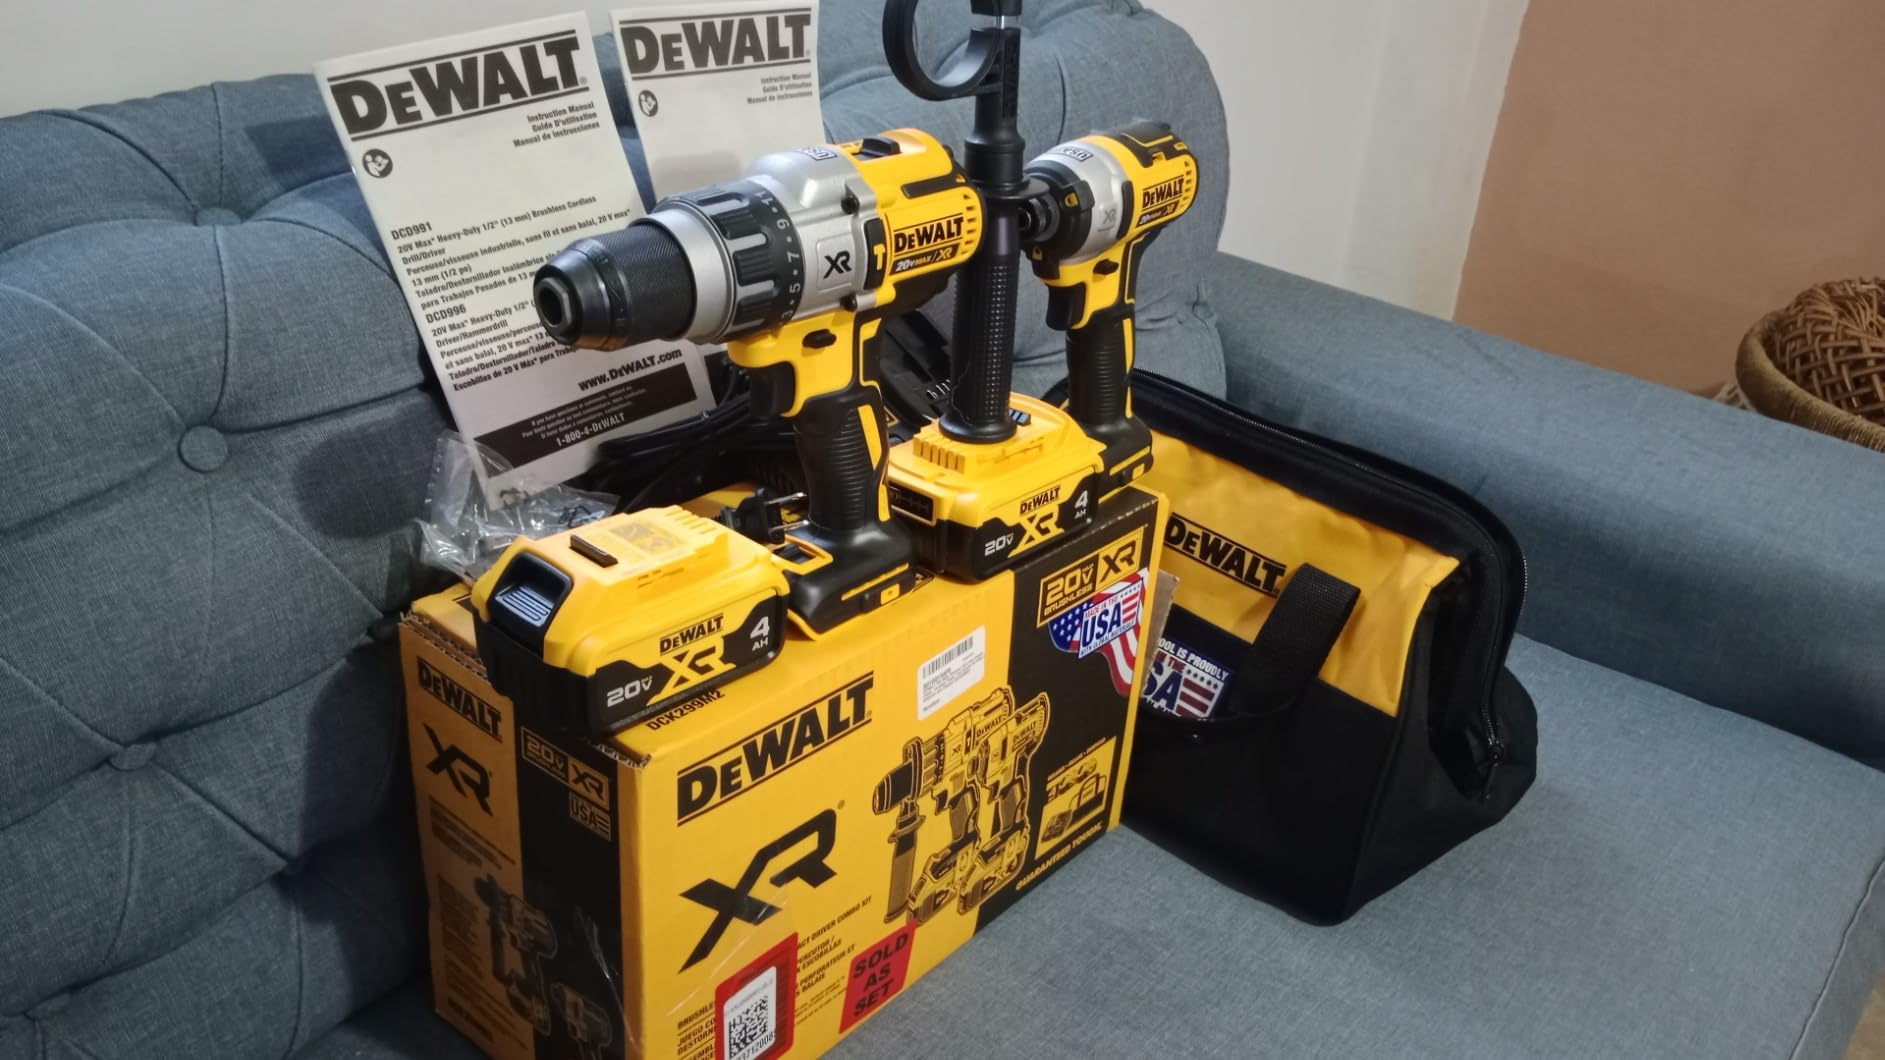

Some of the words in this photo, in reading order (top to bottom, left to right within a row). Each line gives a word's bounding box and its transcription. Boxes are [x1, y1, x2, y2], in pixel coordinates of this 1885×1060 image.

[620, 15, 811, 74] DEWALT
[330, 35, 580, 134] DEWALT
[527, 107, 567, 122] Instruction
[568, 100, 594, 113] Manual
[531, 121, 552, 132] Guide
[554, 111, 597, 127] D'utilisation
[513, 134, 540, 146] Manual
[541, 132, 551, 140] de
[1143, 178, 1185, 209] DEWALT
[390, 221, 432, 241] DCD991
[397, 243, 414, 254] 20V
[436, 224, 481, 244] Heavy-Duty
[499, 216, 513, 227] (13
[513, 212, 531, 223] mm)
[531, 202, 566, 218] Brushless
[566, 194, 596, 208] Cordless
[894, 217, 964, 253] DEWALT
[401, 246, 446, 265] Drill/Driver
[406, 249, 479, 276] Perceuse/visseuse
[524, 233, 541, 243] sans
[542, 230, 551, 238] fil
[560, 223, 577, 233] sans
[597, 215, 607, 223] 20
[787, 251, 800, 263] 7
[411, 278, 422, 287] 13
[423, 274, 439, 283] mm
[439, 267, 458, 280] (1/2
[457, 264, 472, 275] po)
[415, 267, 501, 299] Taladro/Destornillador
[823, 250, 852, 279] XR
[420, 298, 440, 310] para
[439, 287, 474, 305] Trabajos
[474, 278, 505, 293] Pesados
[506, 274, 517, 283] de
[517, 271, 528, 280] 13
[789, 282, 801, 294] 5
[425, 303, 467, 323] DCD996
[431, 325, 447, 336] 20V
[469, 306, 513, 325] Heavy-Duty
[435, 319, 508, 347] Driver/Hammerdrill
[444, 361, 454, 369] et
[454, 355, 474, 366] sans
[496, 343, 507, 352] 20
[534, 331, 543, 340] 13
[448, 341, 556, 380] Taladro/Destornillador/Taladro
[452, 372, 492, 391] Escobillas
[492, 368, 502, 377] de
[502, 364, 512, 374] 20
[512, 362, 519, 370] V
[538, 352, 554, 363] para
[1020, 487, 1060, 514] DEWALT
[985, 533, 1014, 557] 20V
[1007, 503, 1064, 558] XR
[1075, 490, 1088, 509] 4
[1046, 562, 1093, 606] 20V
[1098, 539, 1137, 584] XR
[1164, 516, 1287, 593] DEWALT
[1044, 583, 1093, 616] BRUSHLESS
[660, 615, 724, 654] DEWALT
[1081, 602, 1122, 647] USA
[607, 676, 653, 707] 20V
[646, 634, 737, 707] XR
[750, 616, 770, 640] 4
[752, 637, 769, 651] AH
[1158, 637, 1175, 654] OOL
[1177, 646, 1189, 660] IS
[1187, 653, 1230, 682] PROUDLY
[418, 662, 502, 740] DEWALT
[1144, 661, 1184, 711] SA
[677, 676, 874, 821] DEWALT
[423, 721, 494, 817] XR
[526, 736, 565, 769] 20V
[570, 764, 605, 801] XR
[572, 794, 600, 831] USA
[678, 808, 838, 974] XR
[811, 919, 836, 941] DRIVER
[837, 903, 861, 924] COMBO
[861, 895, 872, 908] KIT
[799, 938, 830, 963] ERCUTOR
[799, 949, 846, 987] PERFORATEUR
[847, 943, 855, 954] ET
[802, 938, 842, 970] ESCOBILLAS
[854, 933, 909, 979] SOLD
[801, 972, 825, 993] BALAIS
[863, 962, 891, 992] AS
[677, 1001, 714, 1030] BRUSHLE
[854, 978, 895, 1017] SET
[677, 1025, 704, 1048] JUEGO
[677, 1026, 716, 1057] DESTORN
